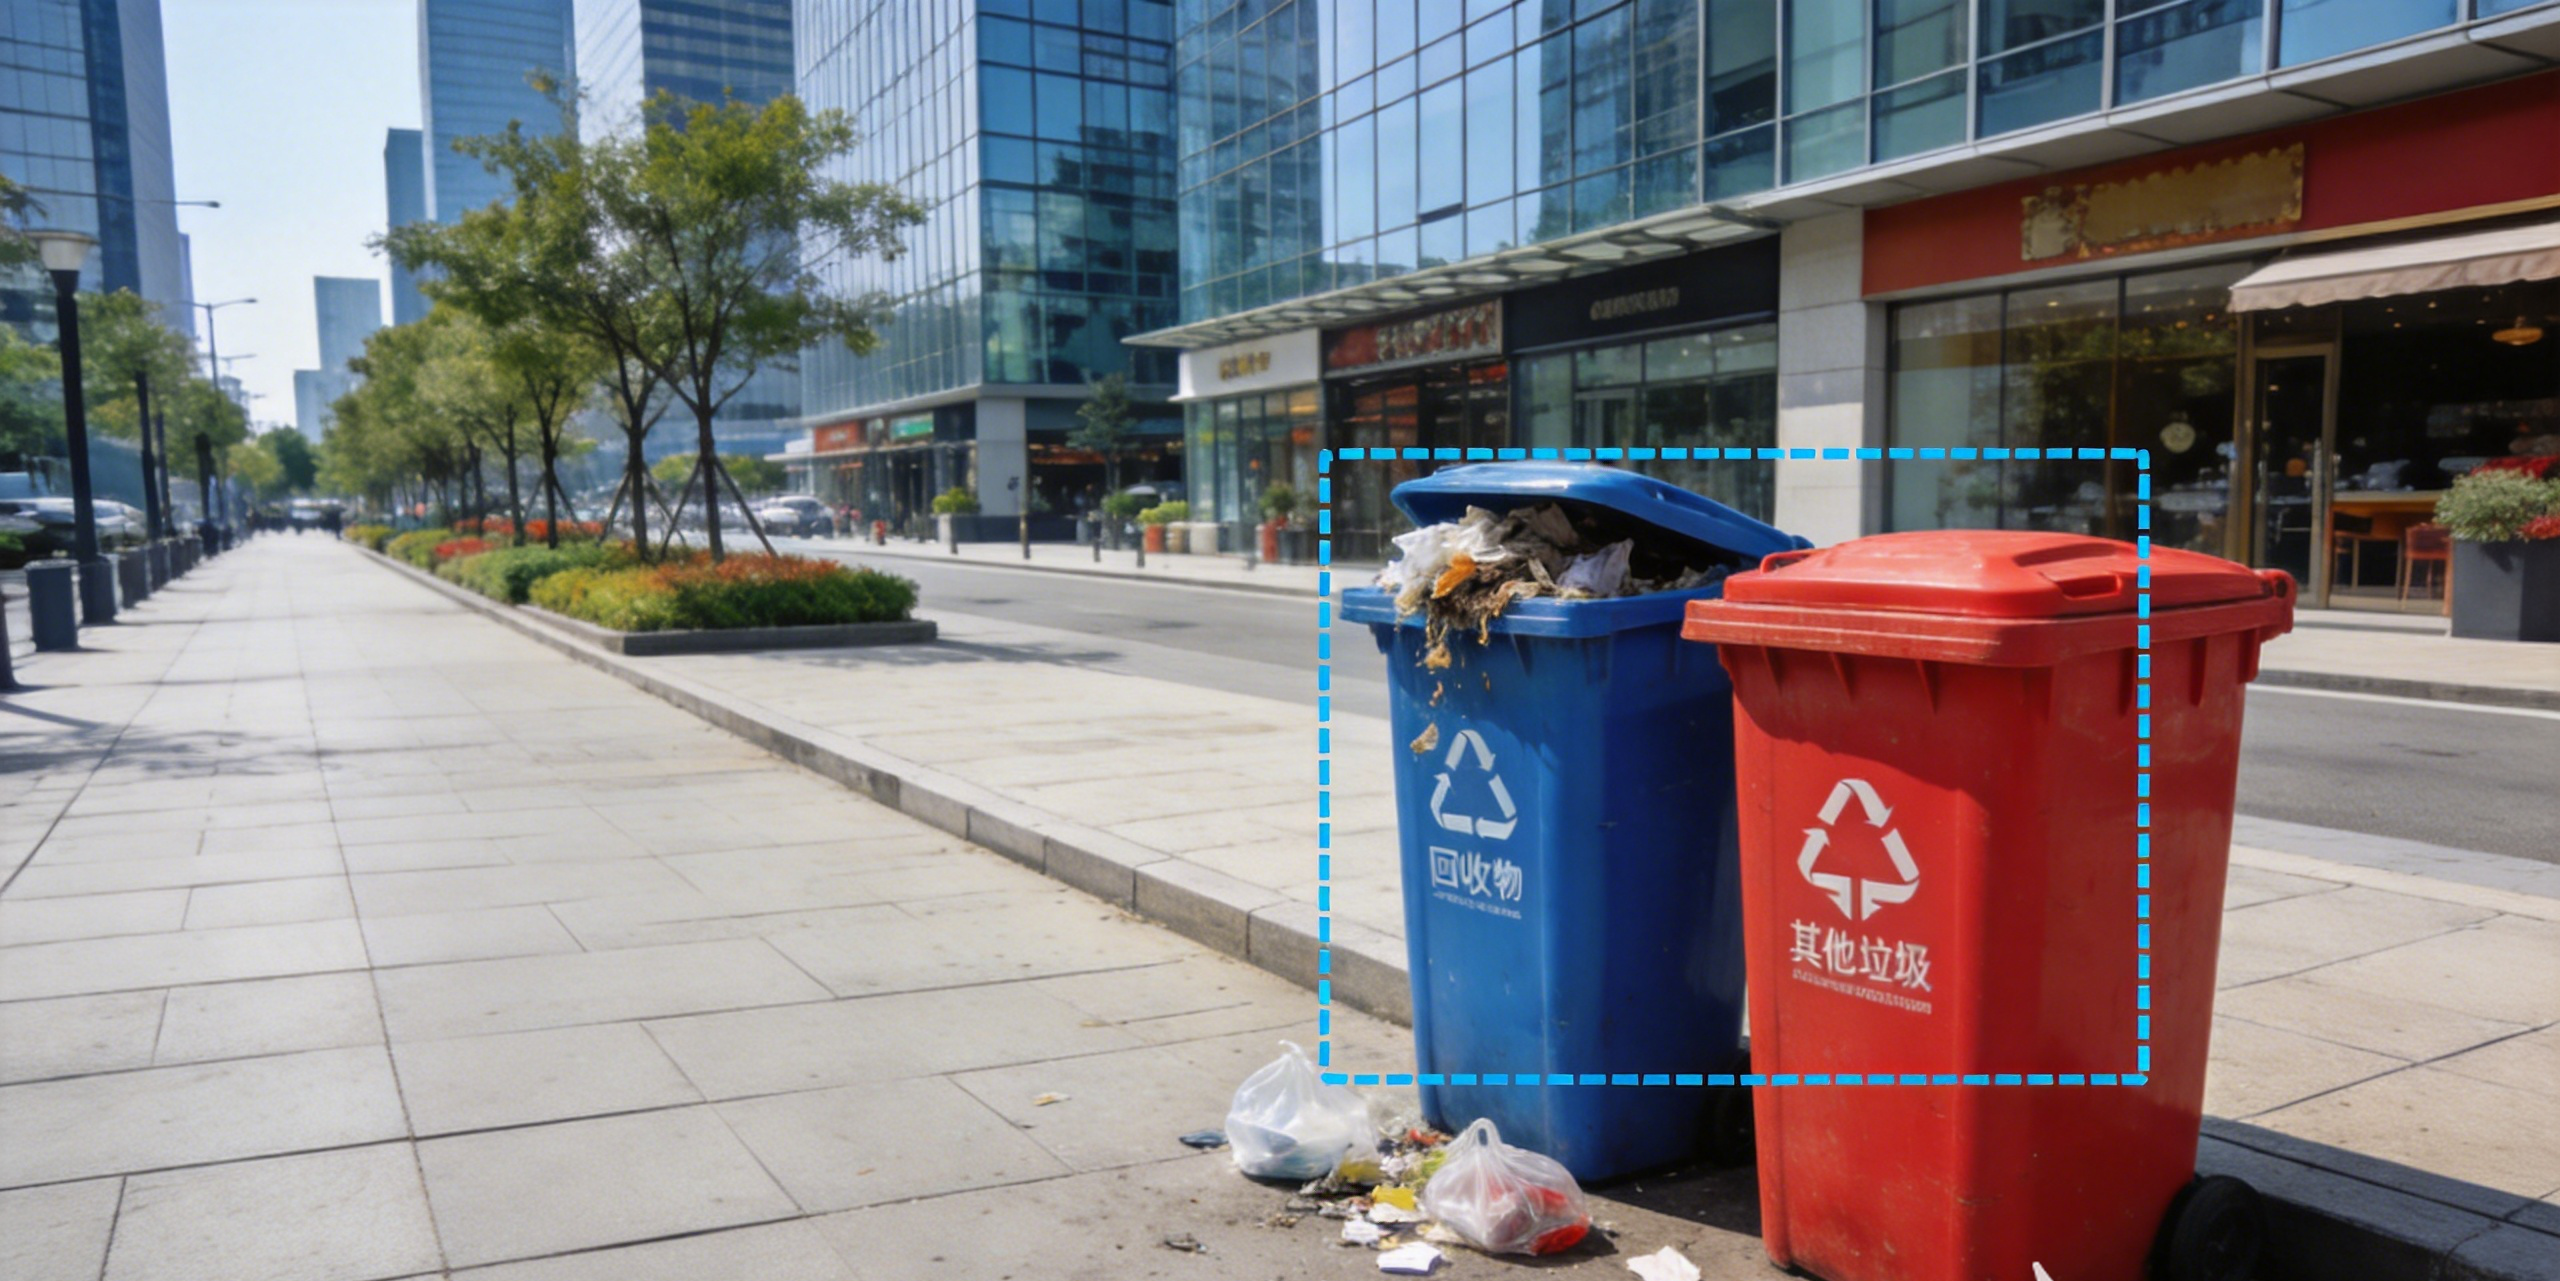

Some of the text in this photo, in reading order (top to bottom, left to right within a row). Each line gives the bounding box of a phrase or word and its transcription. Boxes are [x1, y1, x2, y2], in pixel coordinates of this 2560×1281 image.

[1430, 846, 1523, 902] 回收物
[1790, 919, 1932, 992] 其他垃圾
